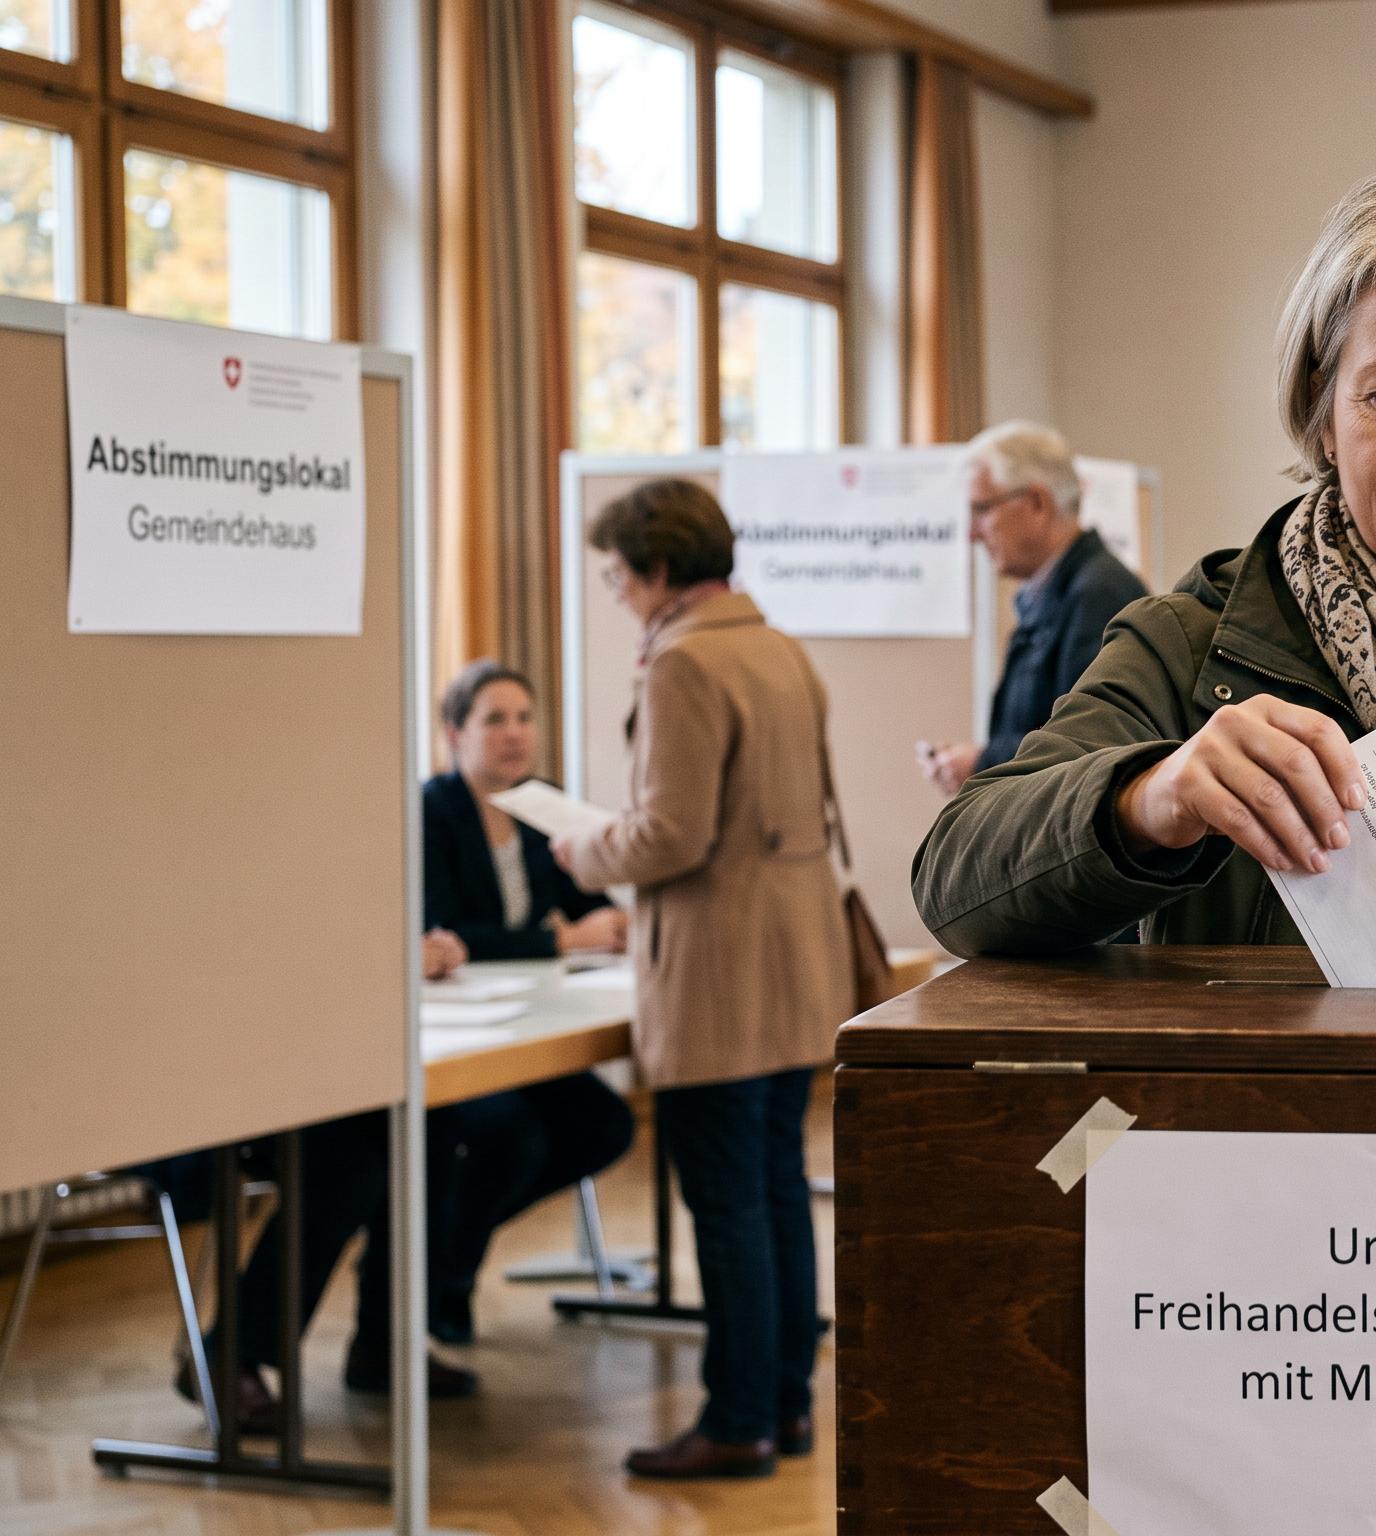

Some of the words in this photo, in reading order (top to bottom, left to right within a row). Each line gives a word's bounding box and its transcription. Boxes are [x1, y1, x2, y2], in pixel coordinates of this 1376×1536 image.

[86, 435, 350, 496] Abstimmungslokal
[127, 503, 317, 551] Gemeindehaus
[1241, 1362, 1314, 1401] mit
